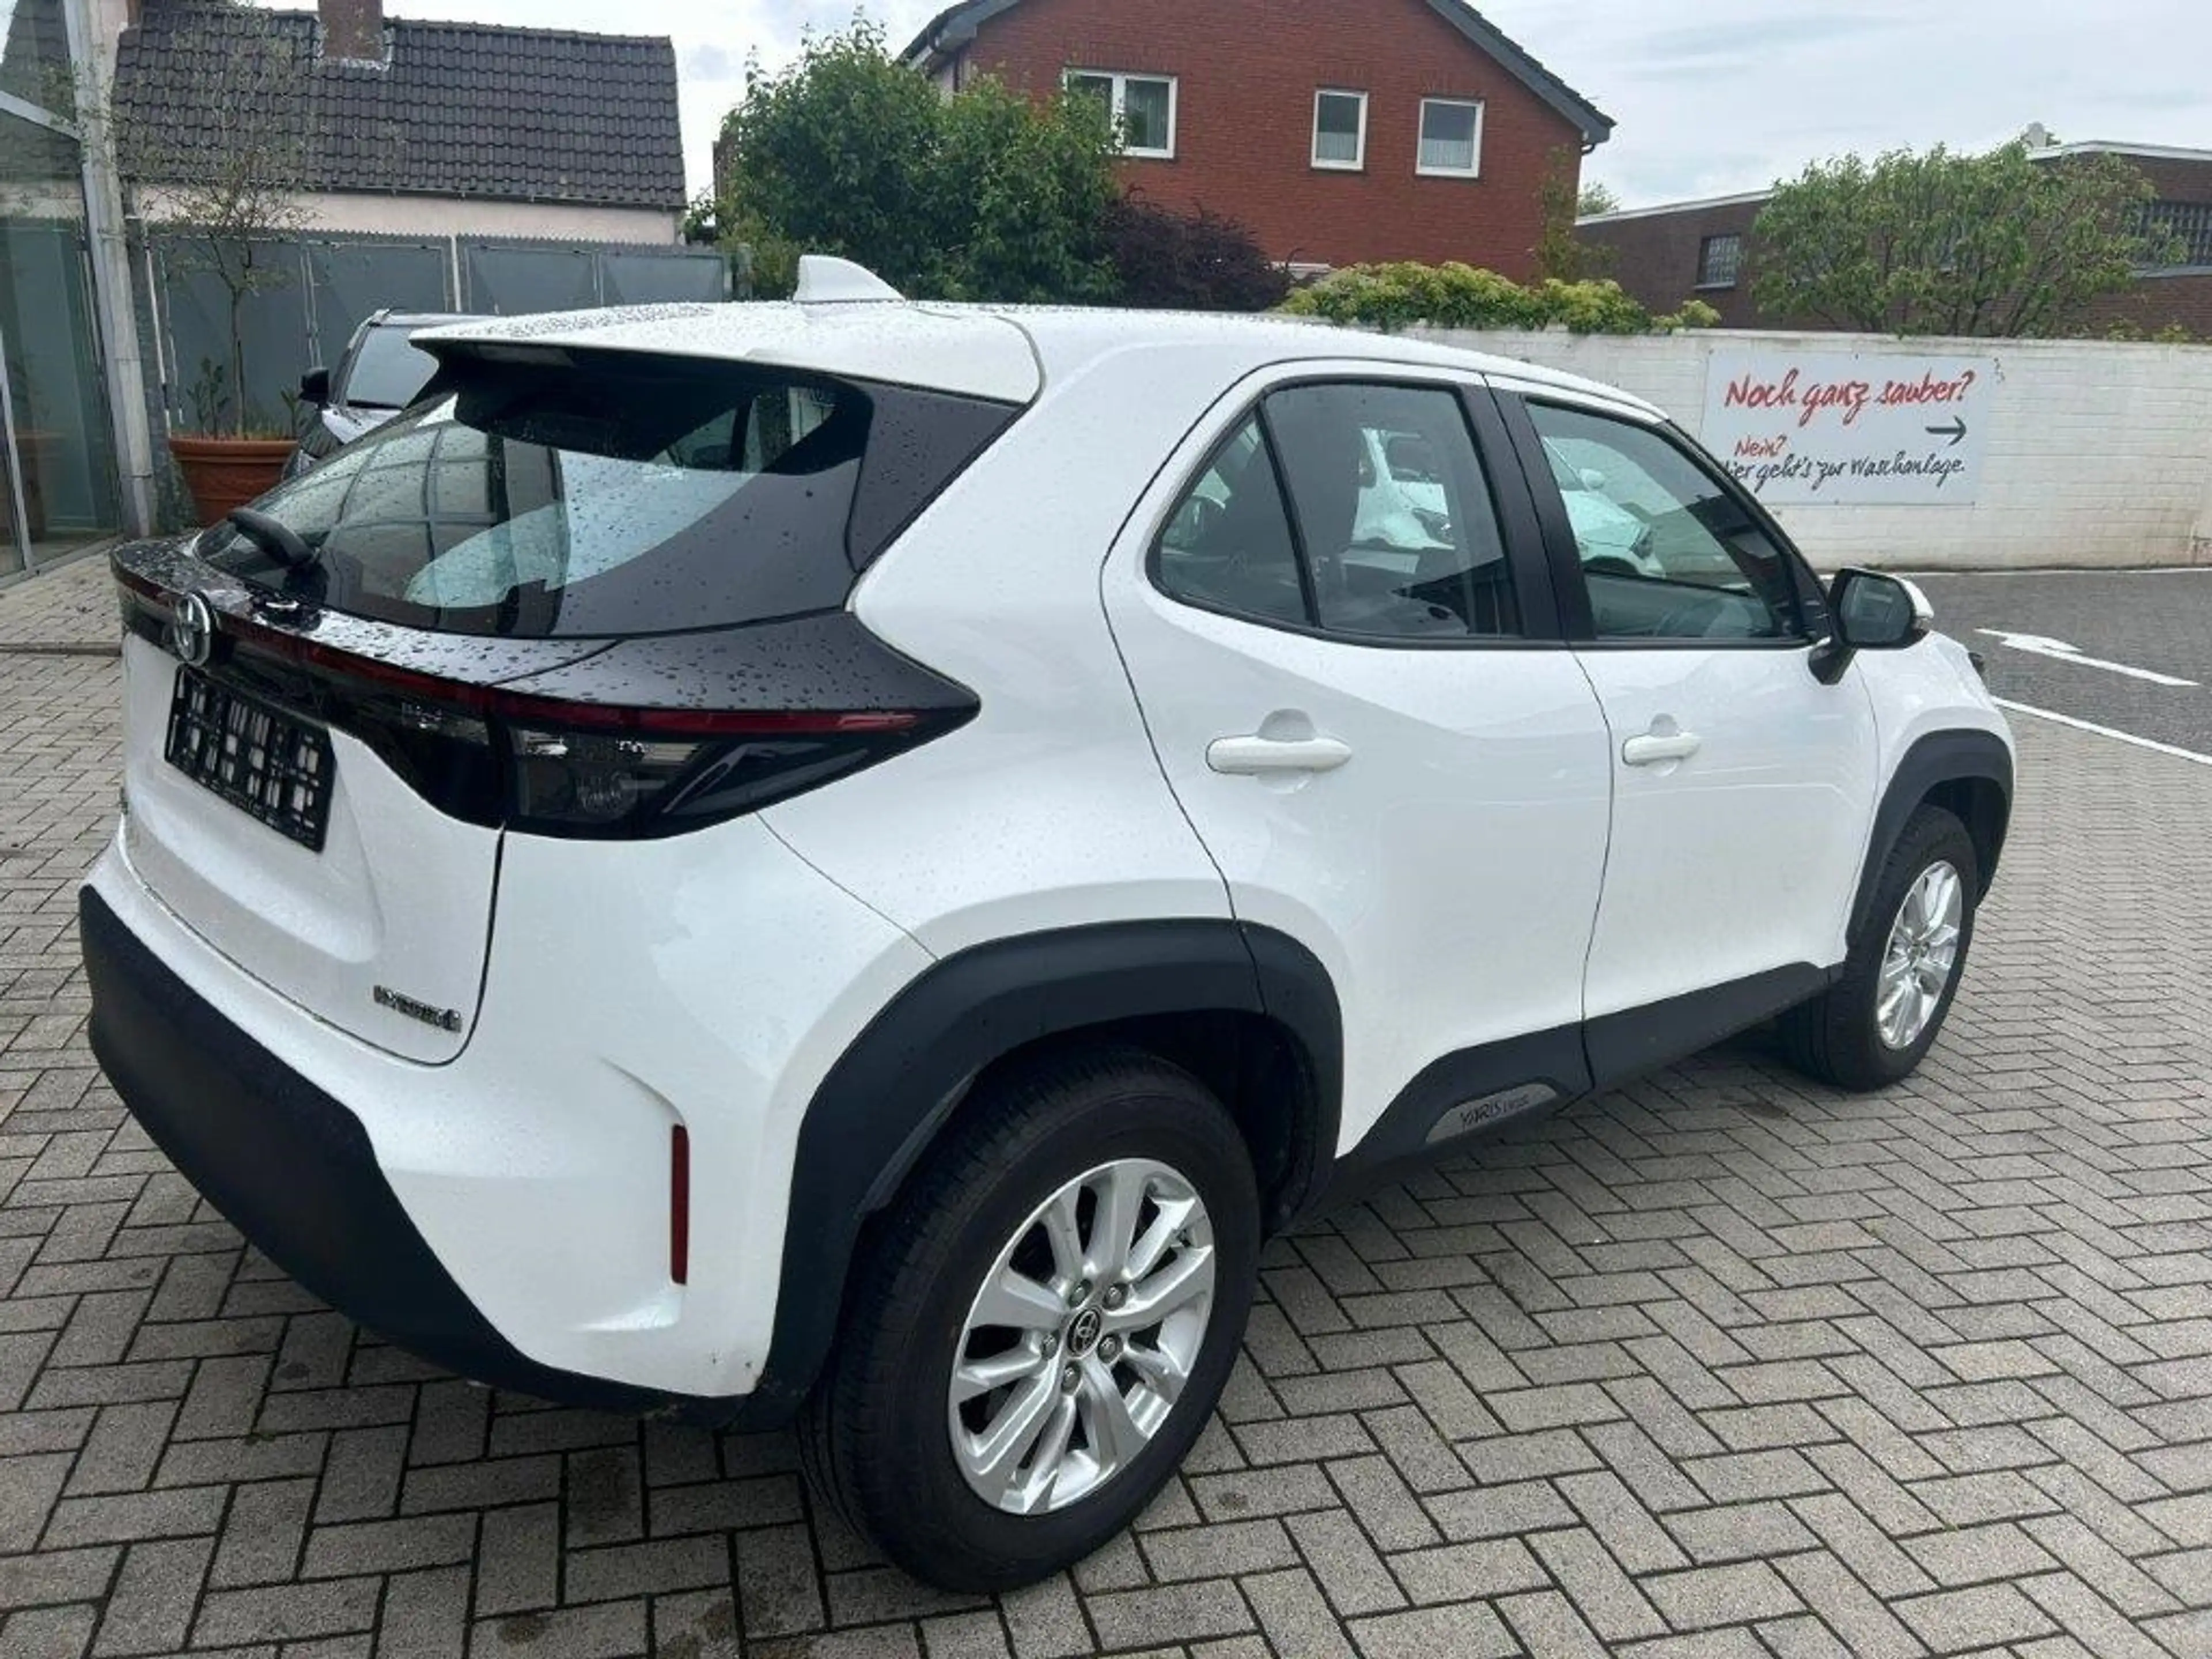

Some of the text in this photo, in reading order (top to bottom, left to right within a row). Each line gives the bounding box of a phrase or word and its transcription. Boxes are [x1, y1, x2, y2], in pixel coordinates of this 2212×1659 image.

[1725, 367, 1976, 427] Noch ganz sauber?
[1734, 435, 1787, 458] Nein?
[1754, 453, 1813, 493] geht's
[1812, 460, 1847, 491] zur
[1851, 450, 1965, 487] Waschanlage.
